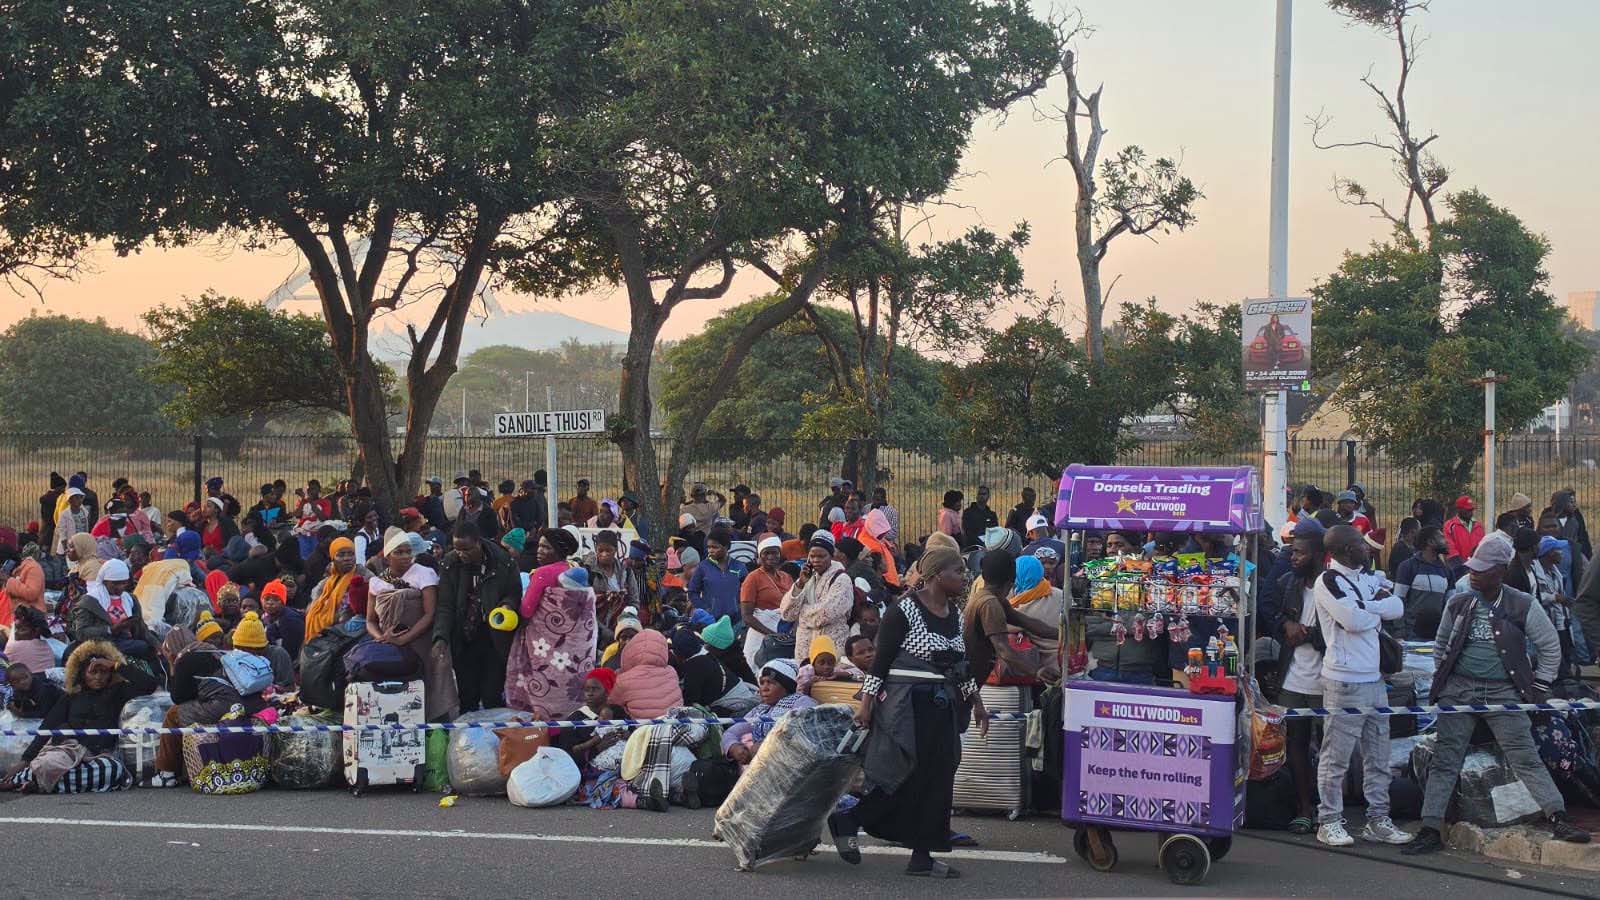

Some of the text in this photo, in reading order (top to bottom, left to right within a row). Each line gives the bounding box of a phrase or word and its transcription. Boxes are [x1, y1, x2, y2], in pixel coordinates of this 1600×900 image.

[1248, 303, 1277, 314] GAS
[498, 411, 602, 434] SANDILE THUSI RD
[1094, 483, 1211, 496] Donsela Trading
[1135, 502, 1186, 512] HOLLYWOOD
[1087, 763, 1203, 787] Keep the fun rolling
